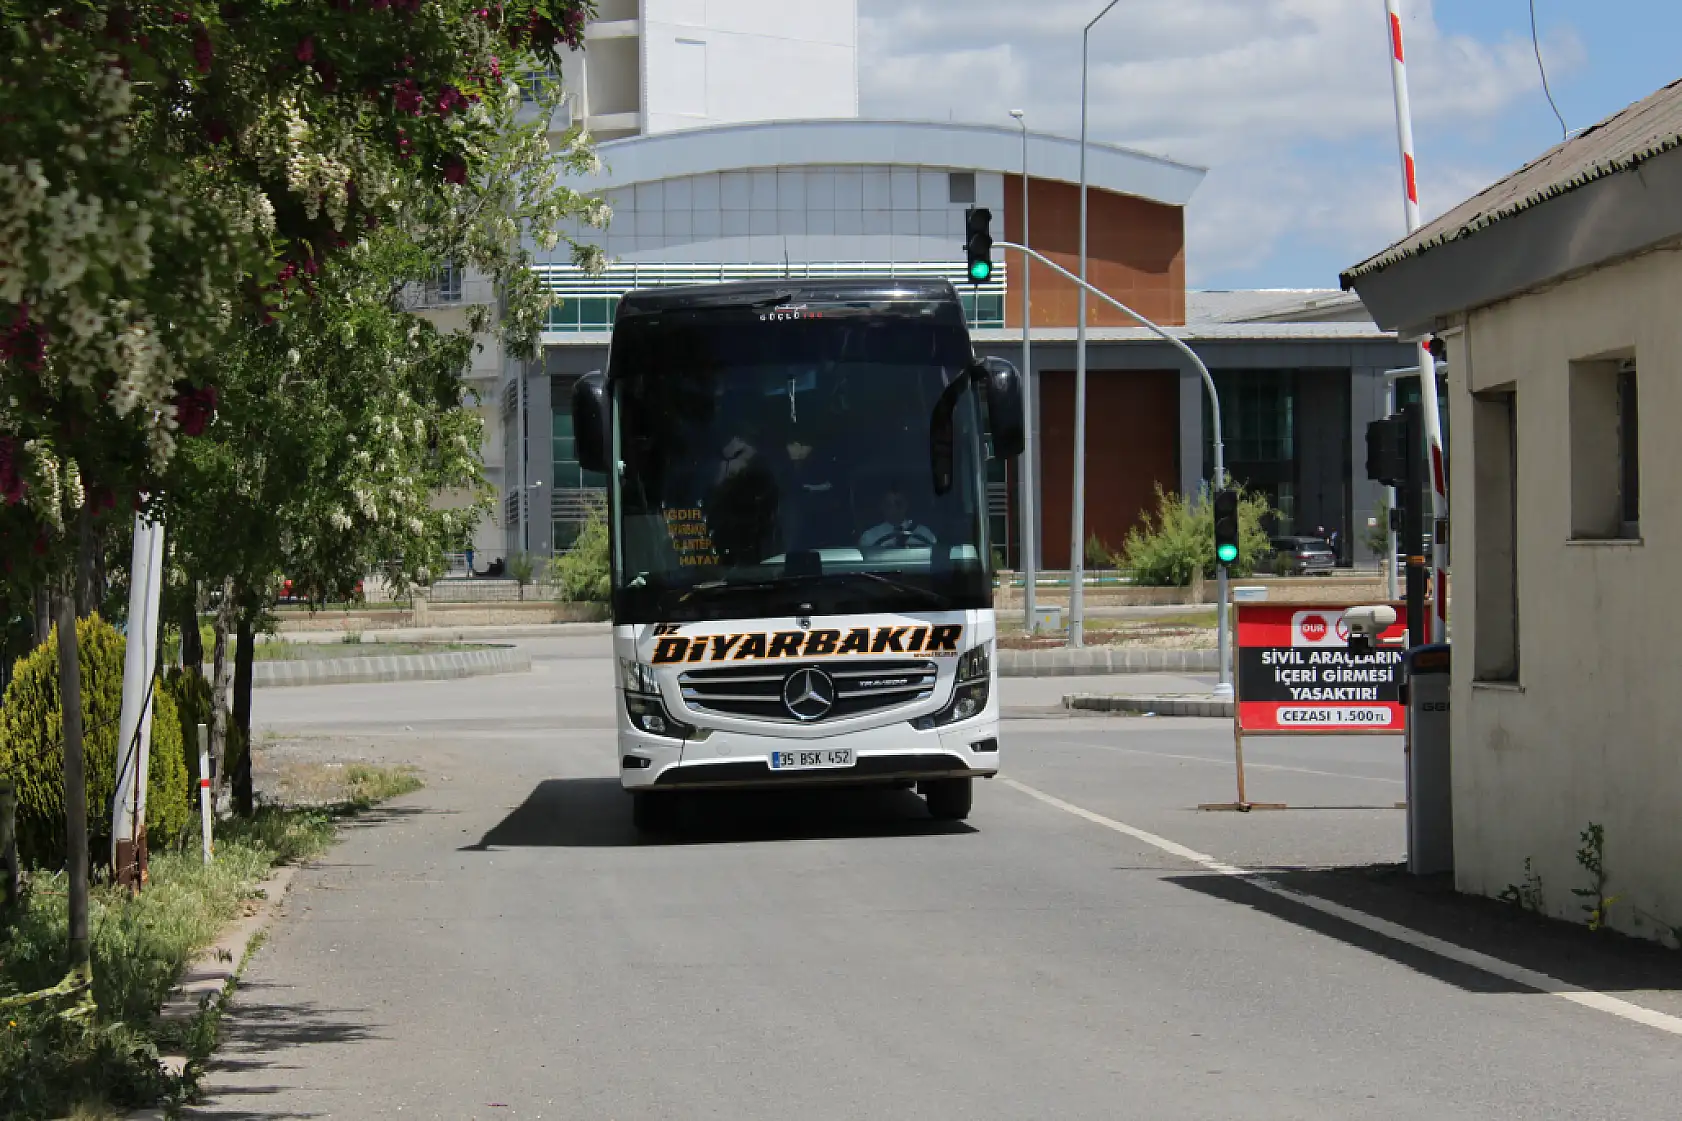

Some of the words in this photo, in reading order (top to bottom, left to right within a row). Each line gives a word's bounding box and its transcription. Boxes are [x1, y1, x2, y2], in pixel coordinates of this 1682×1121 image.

[680, 555, 720, 566] HATAY
[1302, 623, 1325, 632] DUR
[1261, 648, 1304, 664] SİVİL
[1275, 667, 1317, 685] İÇERİ
[1322, 667, 1394, 682] GİRMESİ
[1290, 687, 1377, 700] YASAKTIR!
[1283, 711, 1330, 721] CEZASI
[780, 752, 794, 765] 35
[800, 752, 821, 765] BSK
[828, 751, 849, 764] 452
